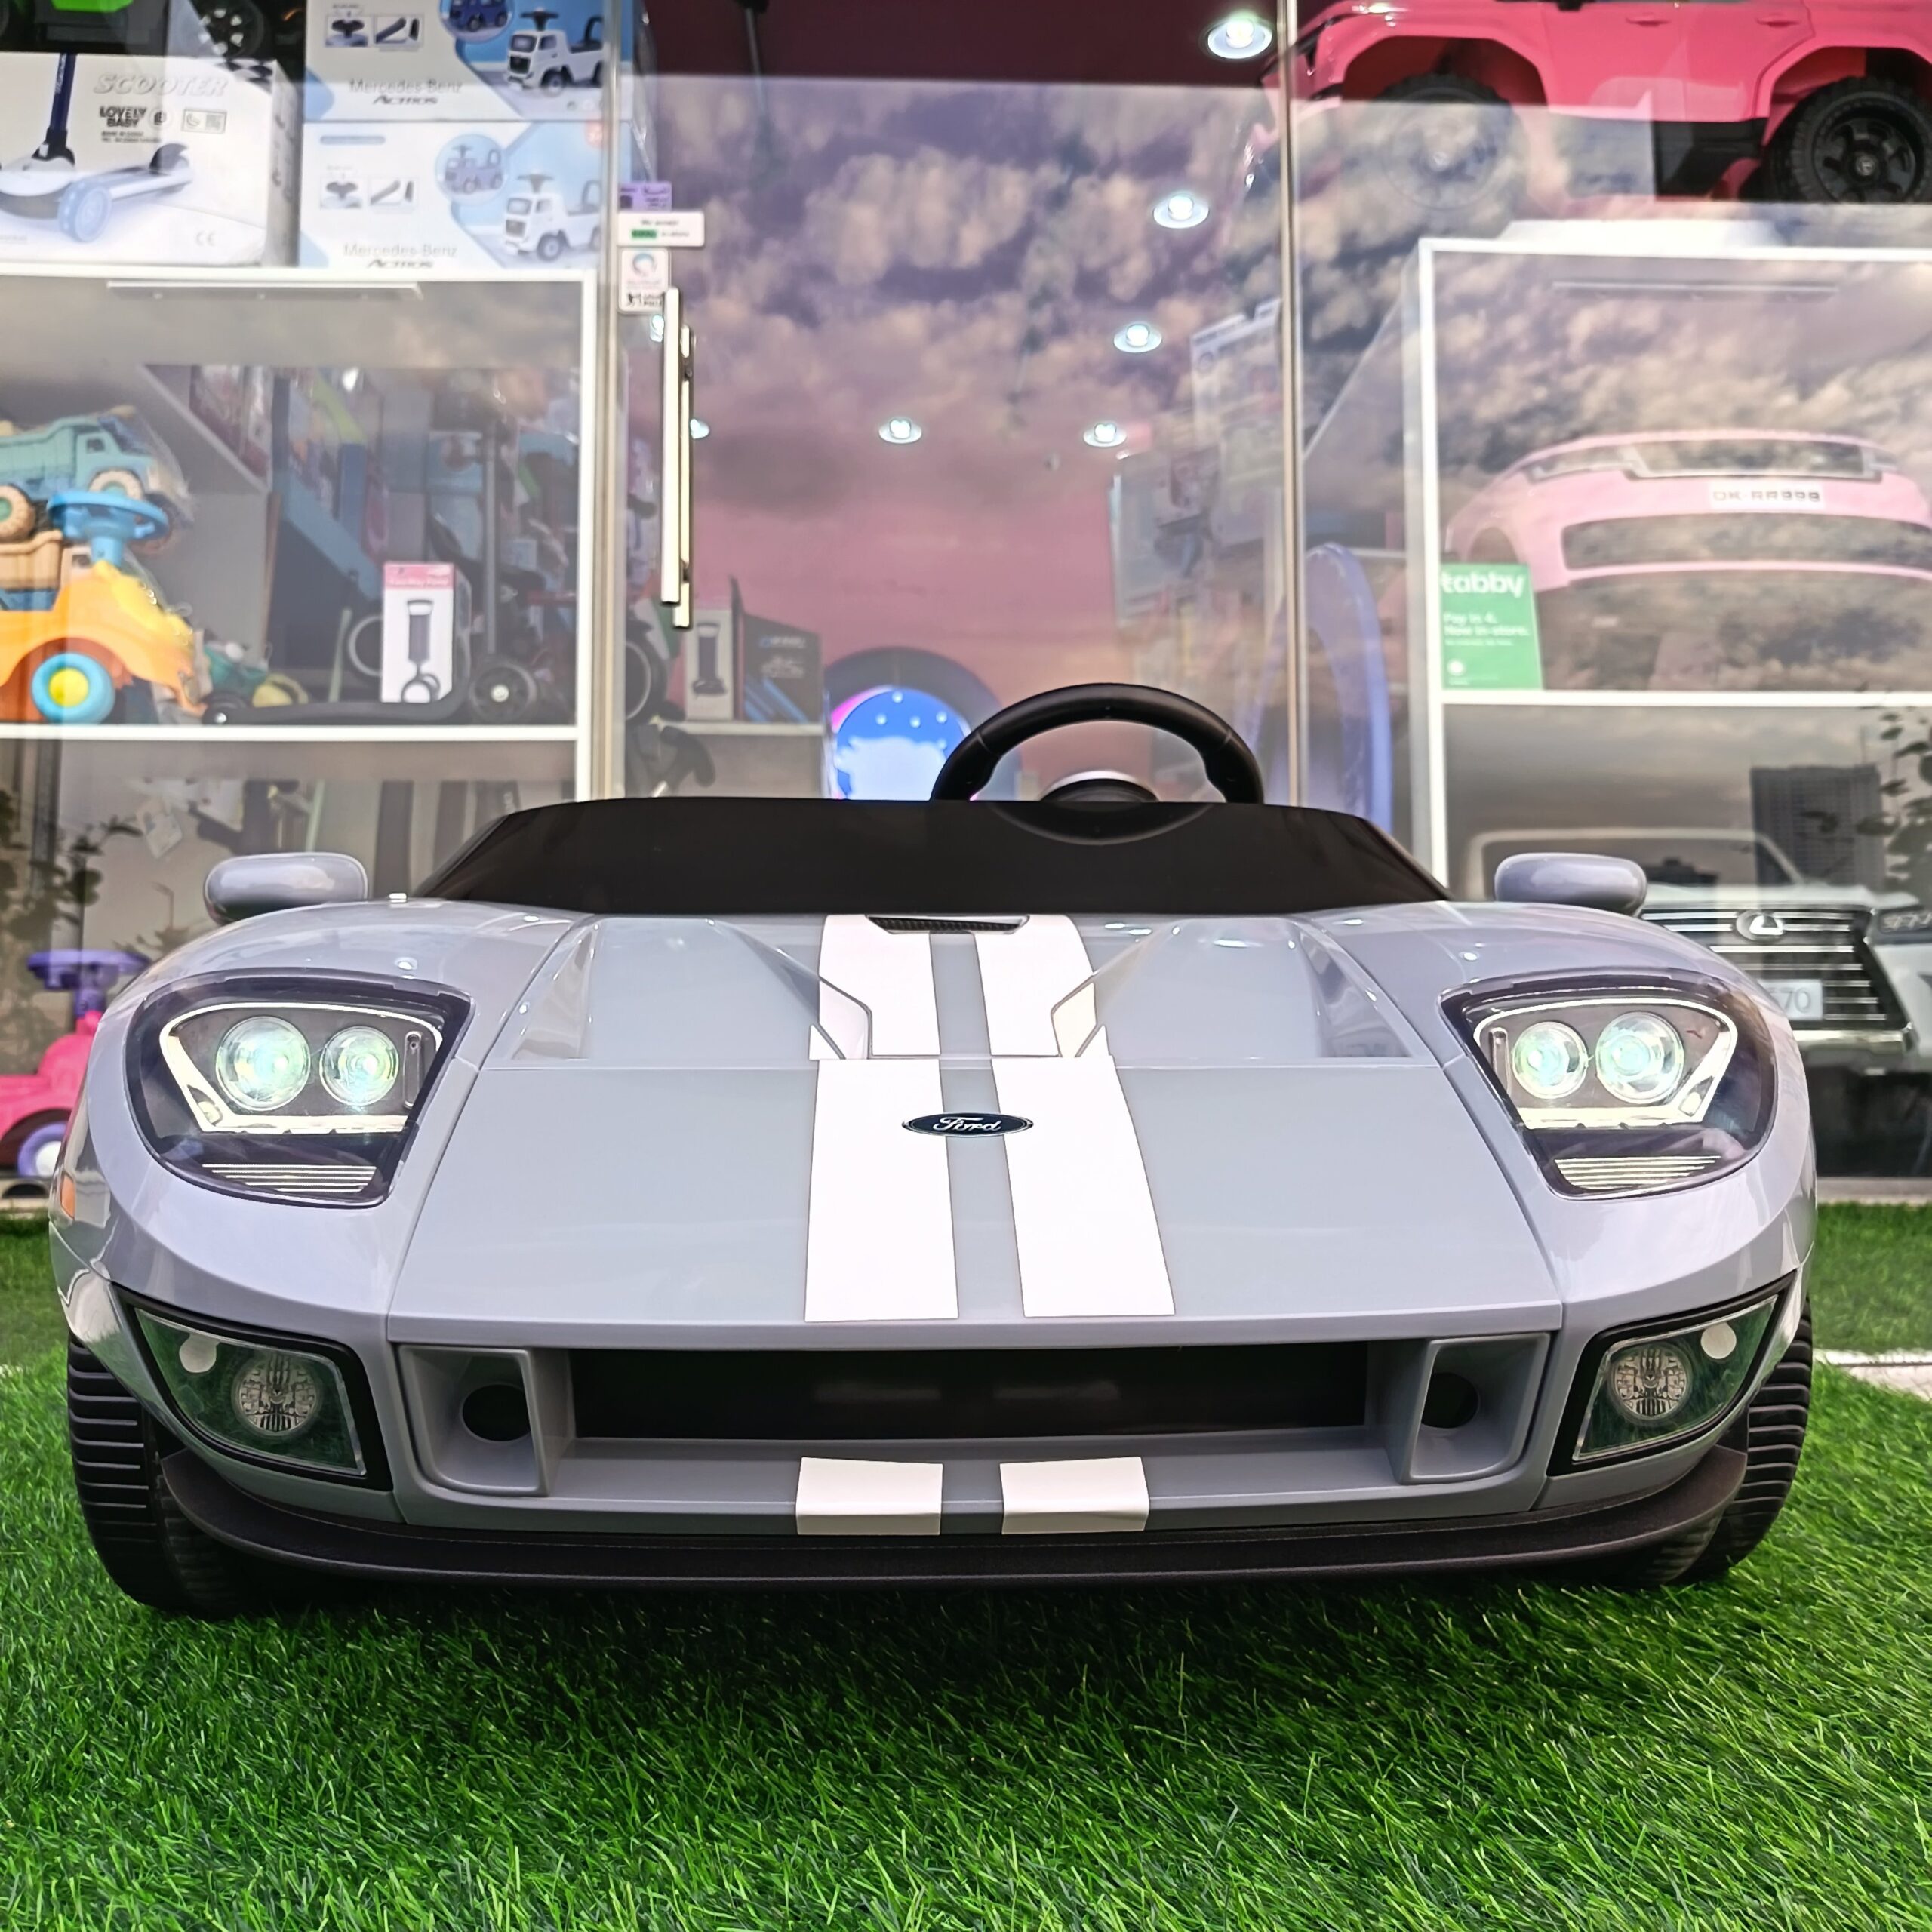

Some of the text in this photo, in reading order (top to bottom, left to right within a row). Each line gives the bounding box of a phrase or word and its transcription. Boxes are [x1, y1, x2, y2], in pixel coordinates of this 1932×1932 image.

[93, 74, 229, 96] SCOOTER
[99, 106, 147, 118] LOVELY
[106, 118, 140, 128] BABY
[1442, 571, 1526, 598] tabby
[932, 1117, 1002, 1132] Ford
